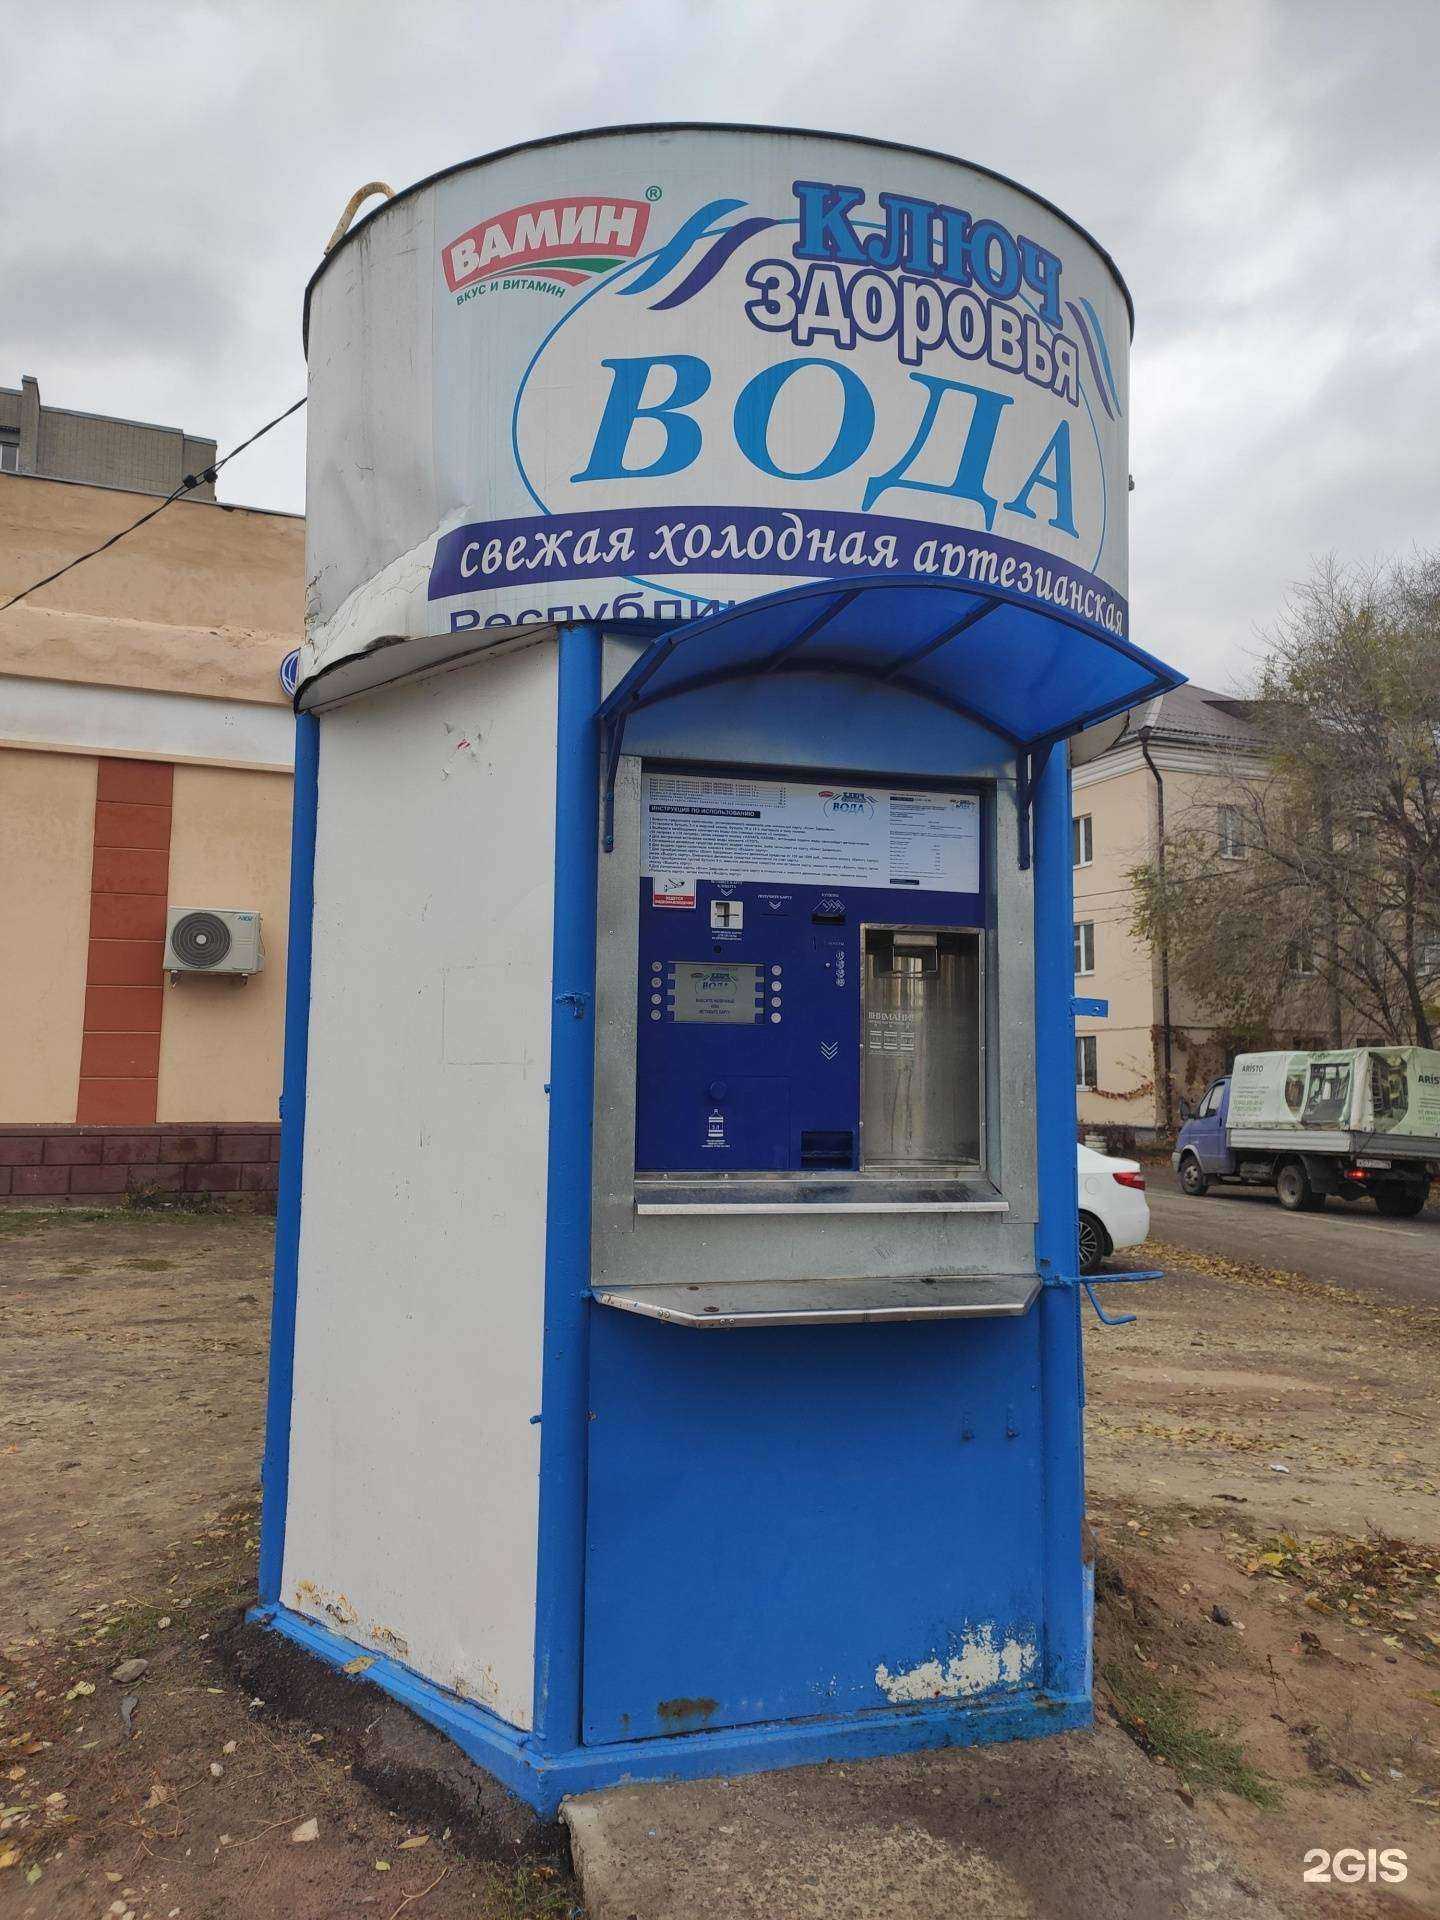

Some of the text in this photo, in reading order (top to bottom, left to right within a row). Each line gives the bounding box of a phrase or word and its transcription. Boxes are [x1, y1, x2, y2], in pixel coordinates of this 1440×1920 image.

[451, 205, 638, 281] ВАМИН
[793, 180, 1063, 330] КЛЮЧ
[456, 279, 566, 306] ВКУС И ВИТАМИН
[570, 354, 1080, 540] ВОДА
[460, 526, 636, 579] свежая
[648, 511, 900, 569] холодная
